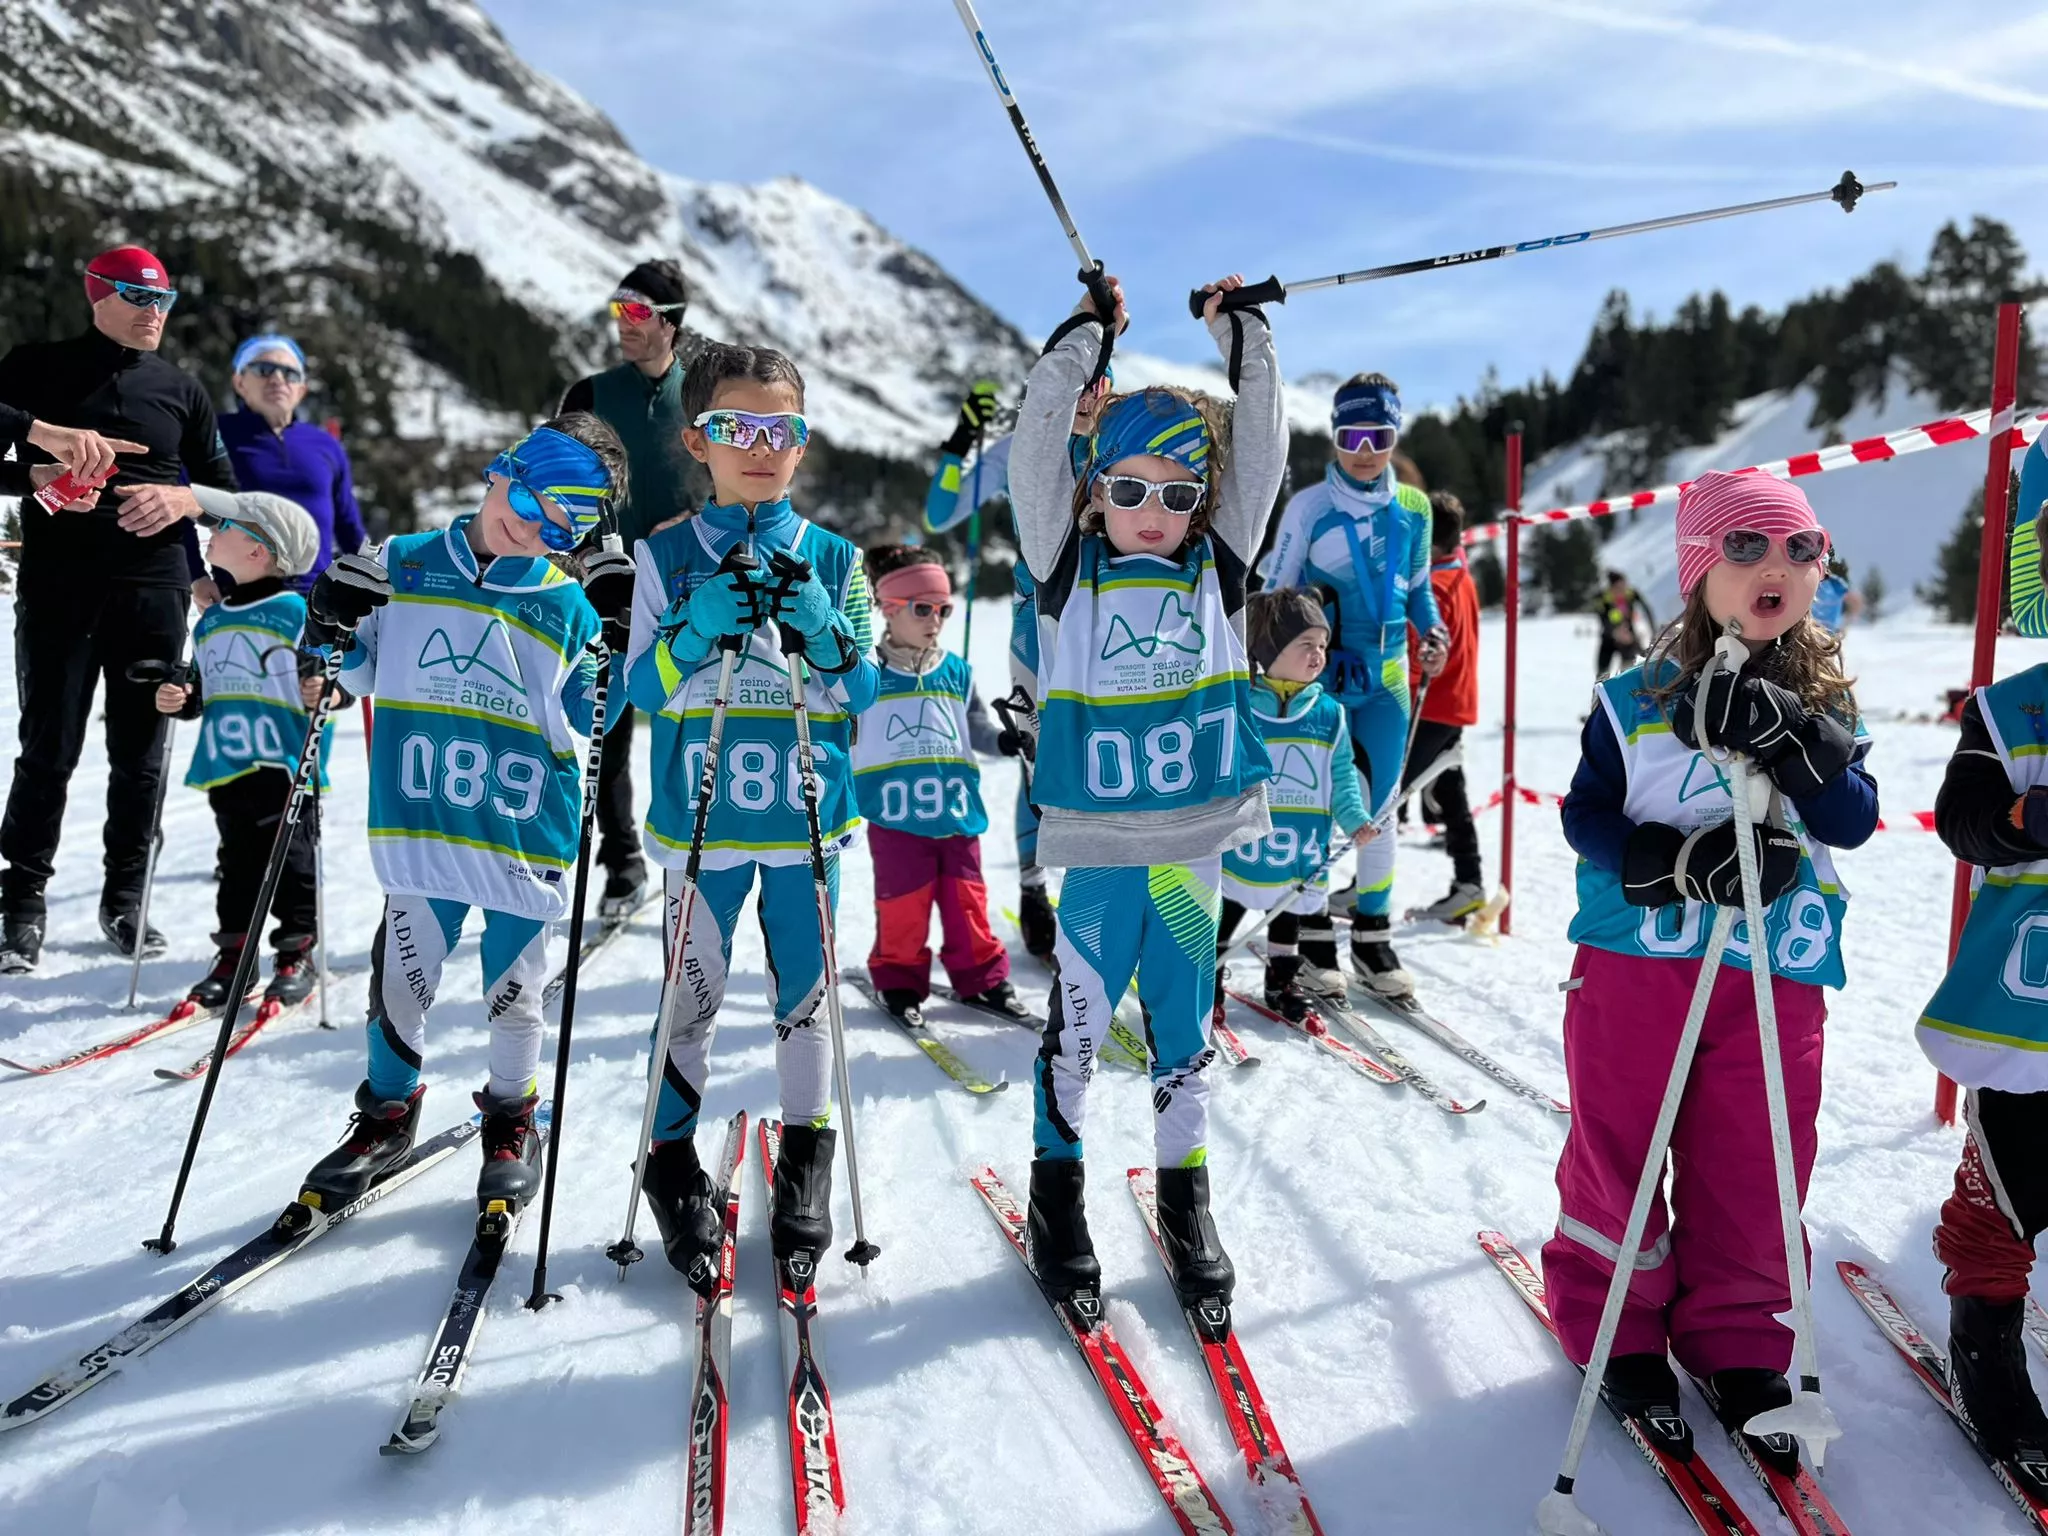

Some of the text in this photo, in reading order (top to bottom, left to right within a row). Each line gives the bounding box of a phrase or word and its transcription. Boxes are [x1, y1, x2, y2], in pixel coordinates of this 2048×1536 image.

[463, 678, 494, 693] reino
[739, 677, 771, 688] reino
[1152, 660, 1181, 671] reino
[460, 688, 529, 718] aneto
[398, 731, 549, 824] 089
[582, 686, 609, 818] salomon
[682, 739, 830, 815] 086
[700, 735, 721, 796] LEKI
[798, 738, 817, 797] LEKI
[1084, 703, 1236, 801] 087
[880, 776, 969, 822] 093
[392, 909, 418, 967] A.D.H.
[327, 1188, 381, 1230] salomon
[1052, 1302, 1081, 1348] ATOMIC
[1847, 1270, 1920, 1340] ATOMIC
[1118, 1378, 1141, 1404] SKI
[1235, 1389, 1253, 1416] SKI
[1620, 1419, 1667, 1480] ATOMIC
[1730, 1427, 1771, 1488] ATOMIC
[1990, 1459, 2040, 1526] ATOMIC
